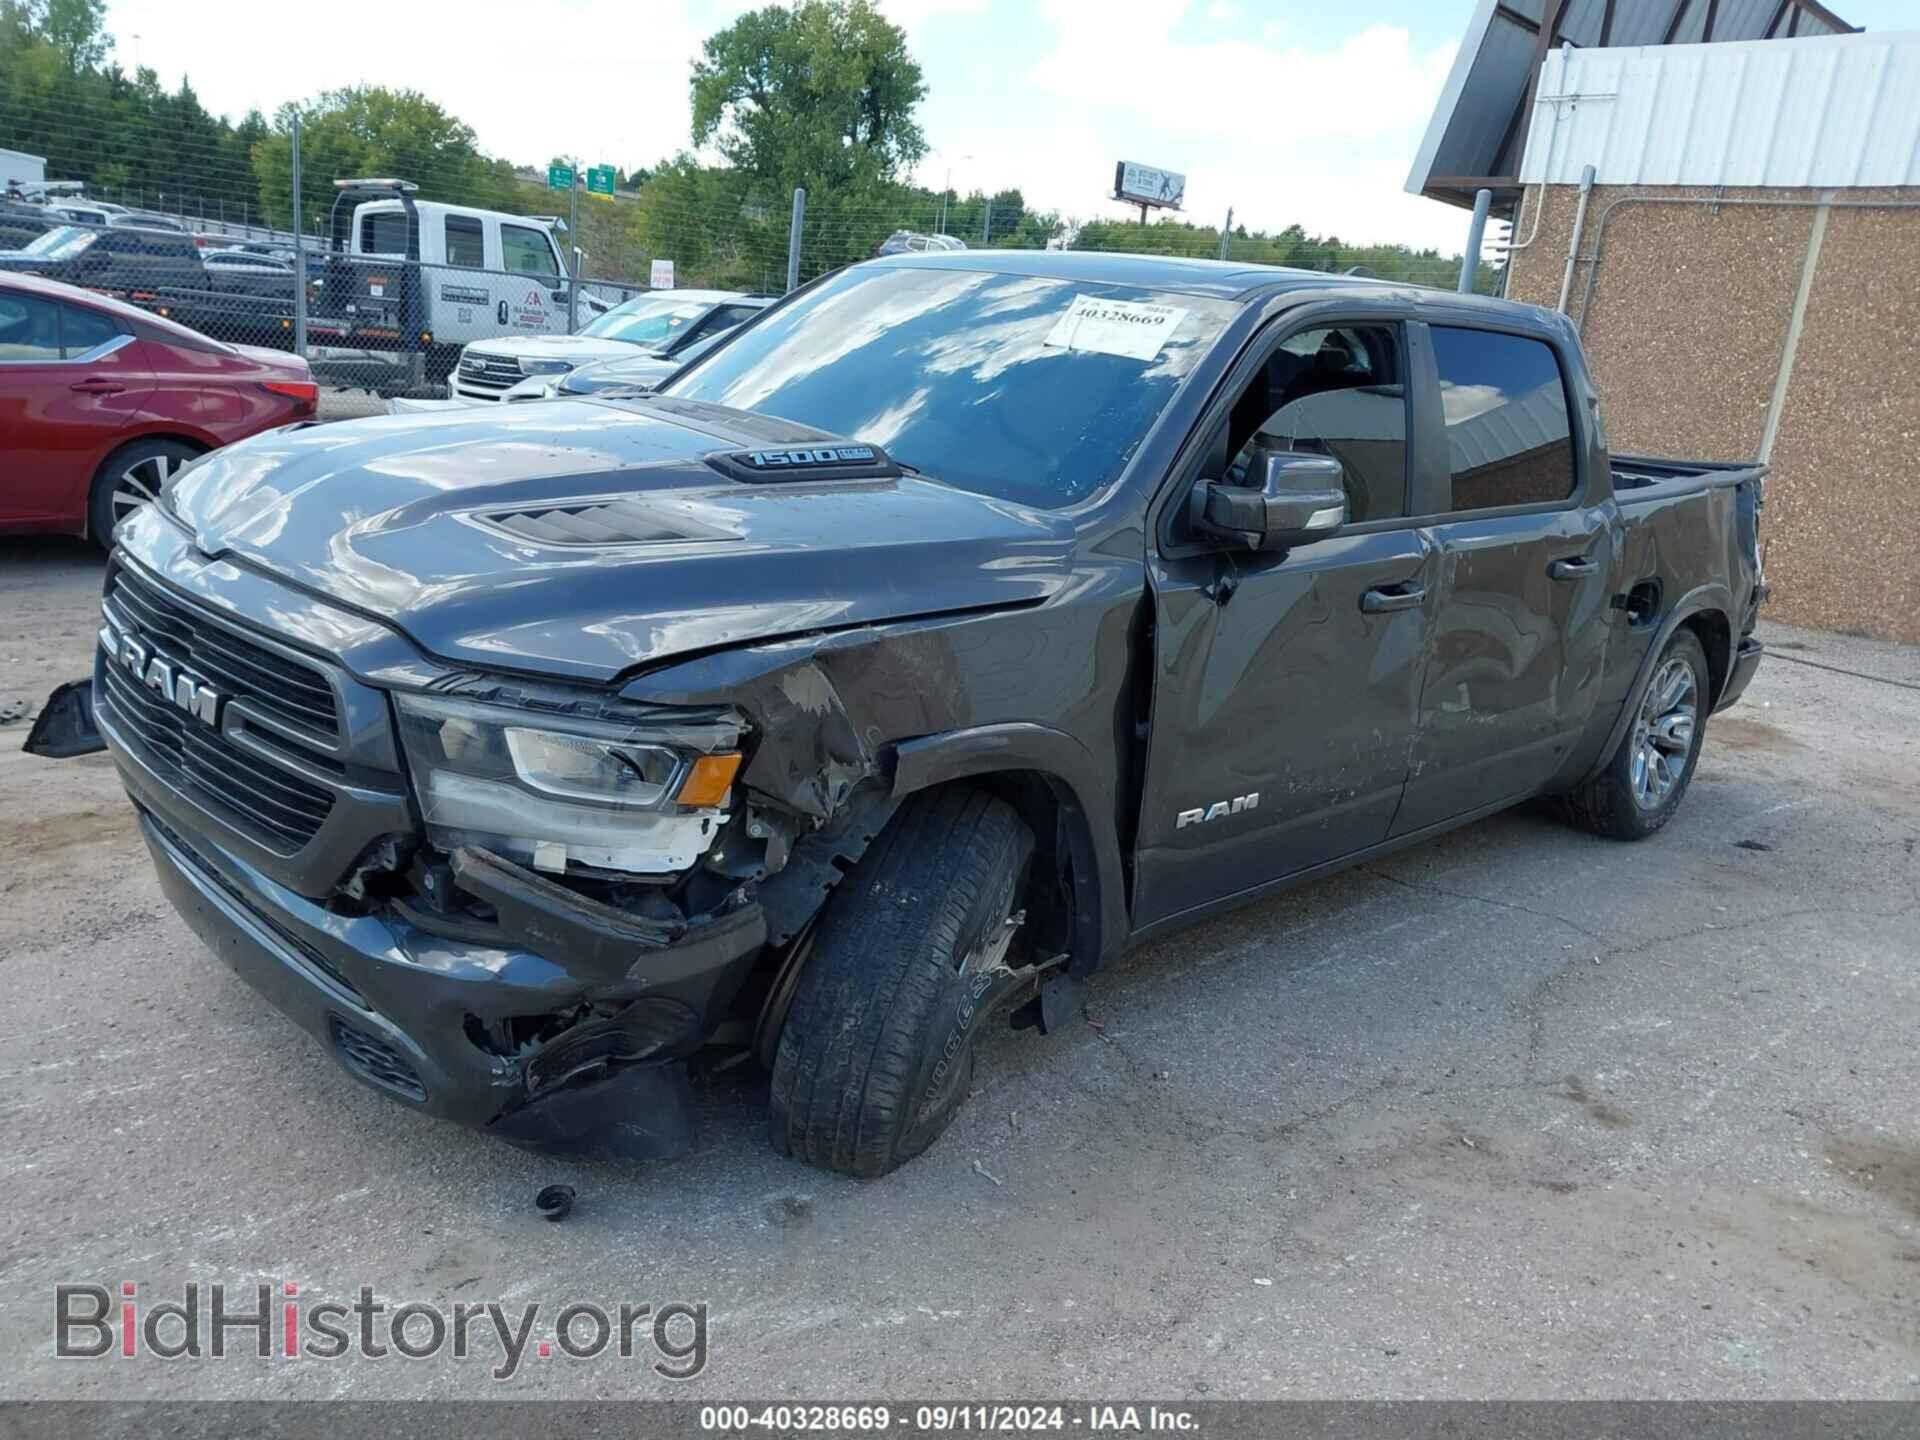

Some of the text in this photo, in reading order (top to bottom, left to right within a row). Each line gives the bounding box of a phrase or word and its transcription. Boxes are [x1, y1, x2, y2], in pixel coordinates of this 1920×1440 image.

[750, 448, 839, 465] 1500
[120, 634, 218, 726] RAM
[1176, 792, 1259, 829] RAM
